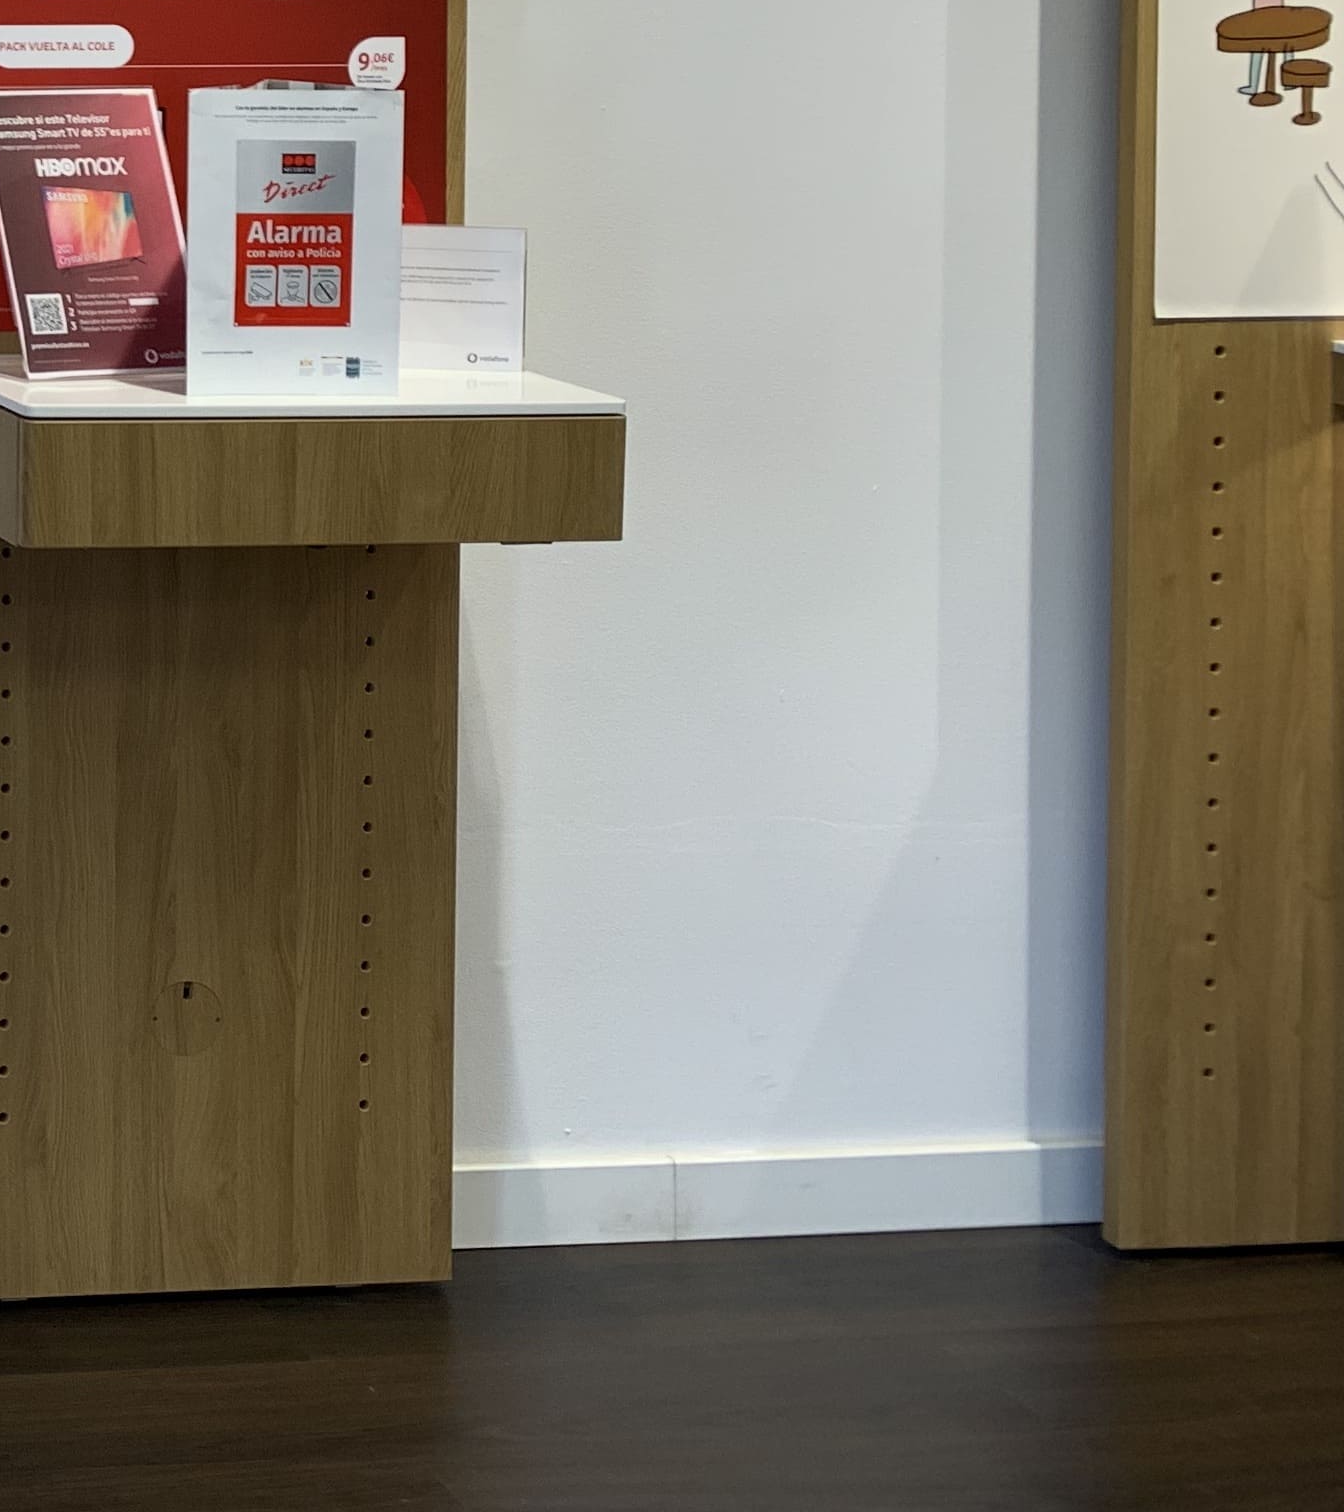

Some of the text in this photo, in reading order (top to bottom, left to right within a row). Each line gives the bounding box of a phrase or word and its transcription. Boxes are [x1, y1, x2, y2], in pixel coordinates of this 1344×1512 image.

[0, 42, 115, 51] PACK VUELTA AL COLE
[35, 114, 44, 125] si
[45, 114, 65, 124] este
[66, 113, 109, 124] Televisor
[37, 128, 66, 139] Smart
[67, 128, 80, 138] TV
[81, 127, 94, 137] de
[122, 128, 142, 138] para
[142, 126, 151, 137] ti
[263, 173, 336, 203] Direct
[246, 219, 342, 244] Alarma
[246, 249, 266, 258] con
[267, 247, 295, 258] aviso
[297, 249, 304, 258] a
